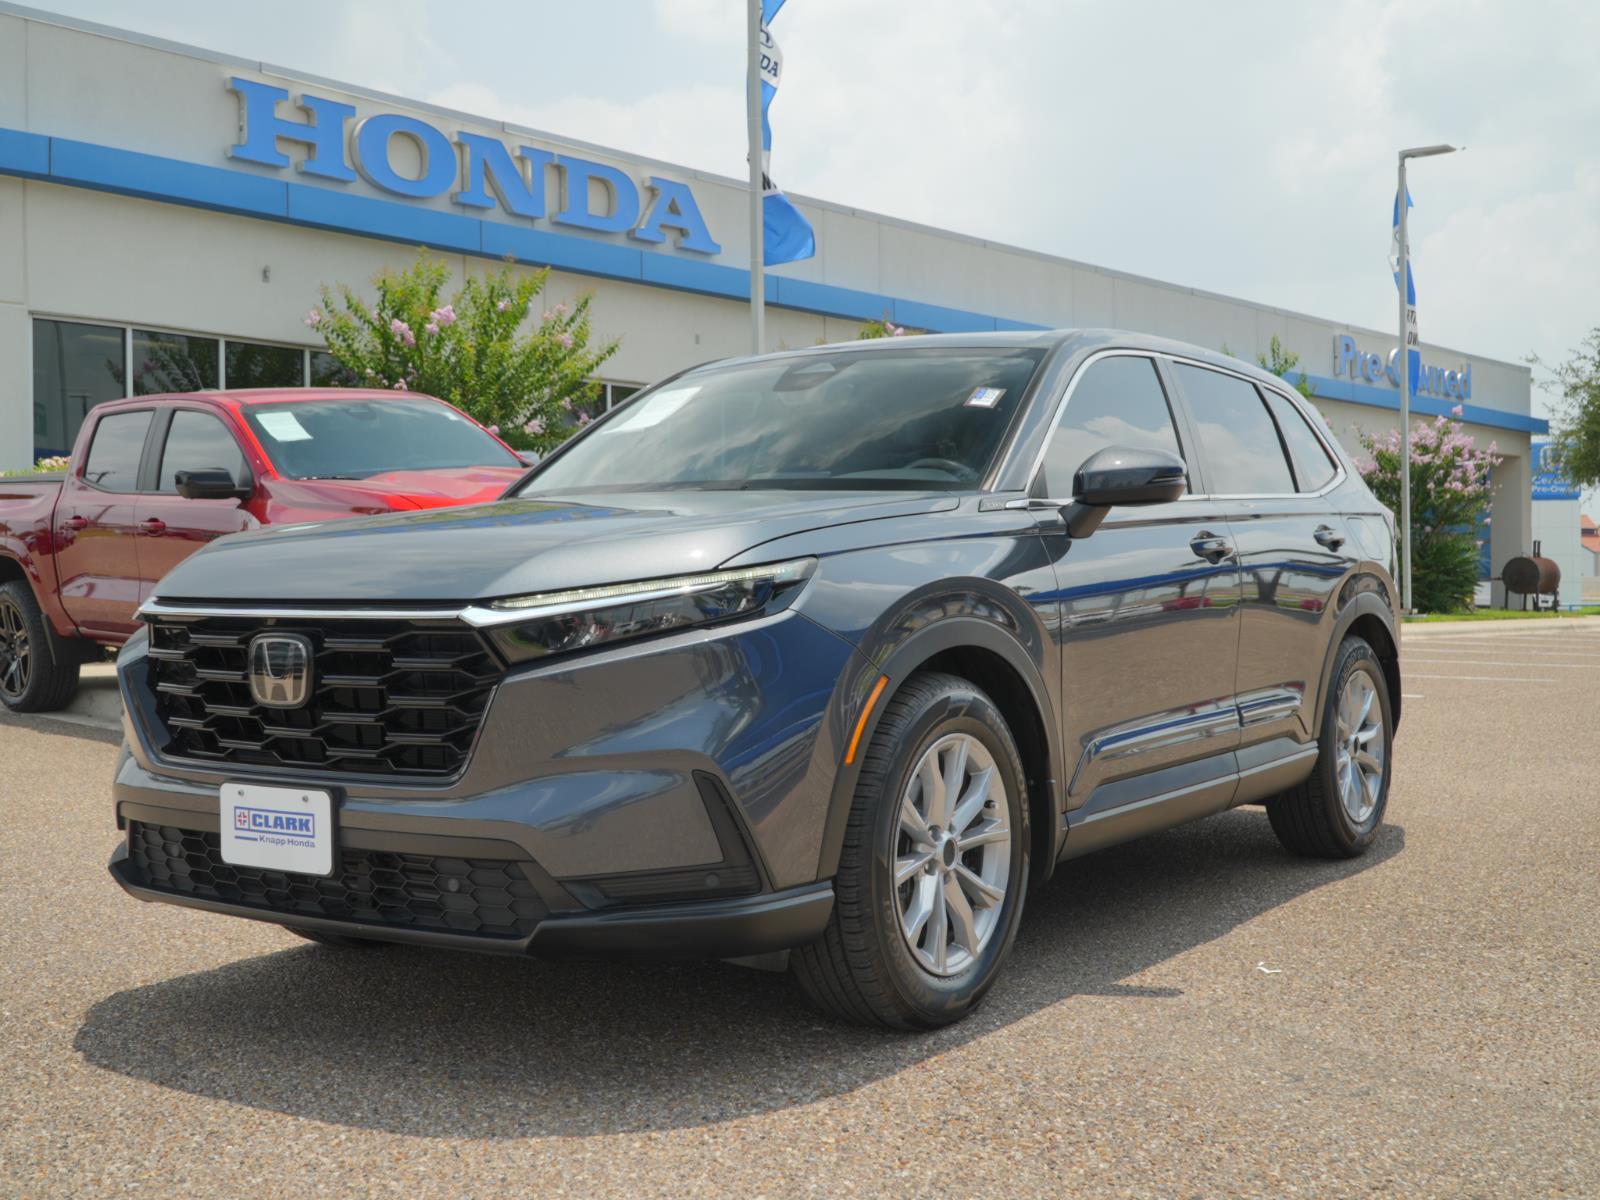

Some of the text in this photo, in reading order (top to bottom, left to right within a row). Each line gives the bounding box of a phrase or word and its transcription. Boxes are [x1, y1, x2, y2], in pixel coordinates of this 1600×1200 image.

[225, 76, 721, 255] HONDA
[251, 813, 311, 832] CLARK
[259, 835, 315, 848] Knapp Honda
